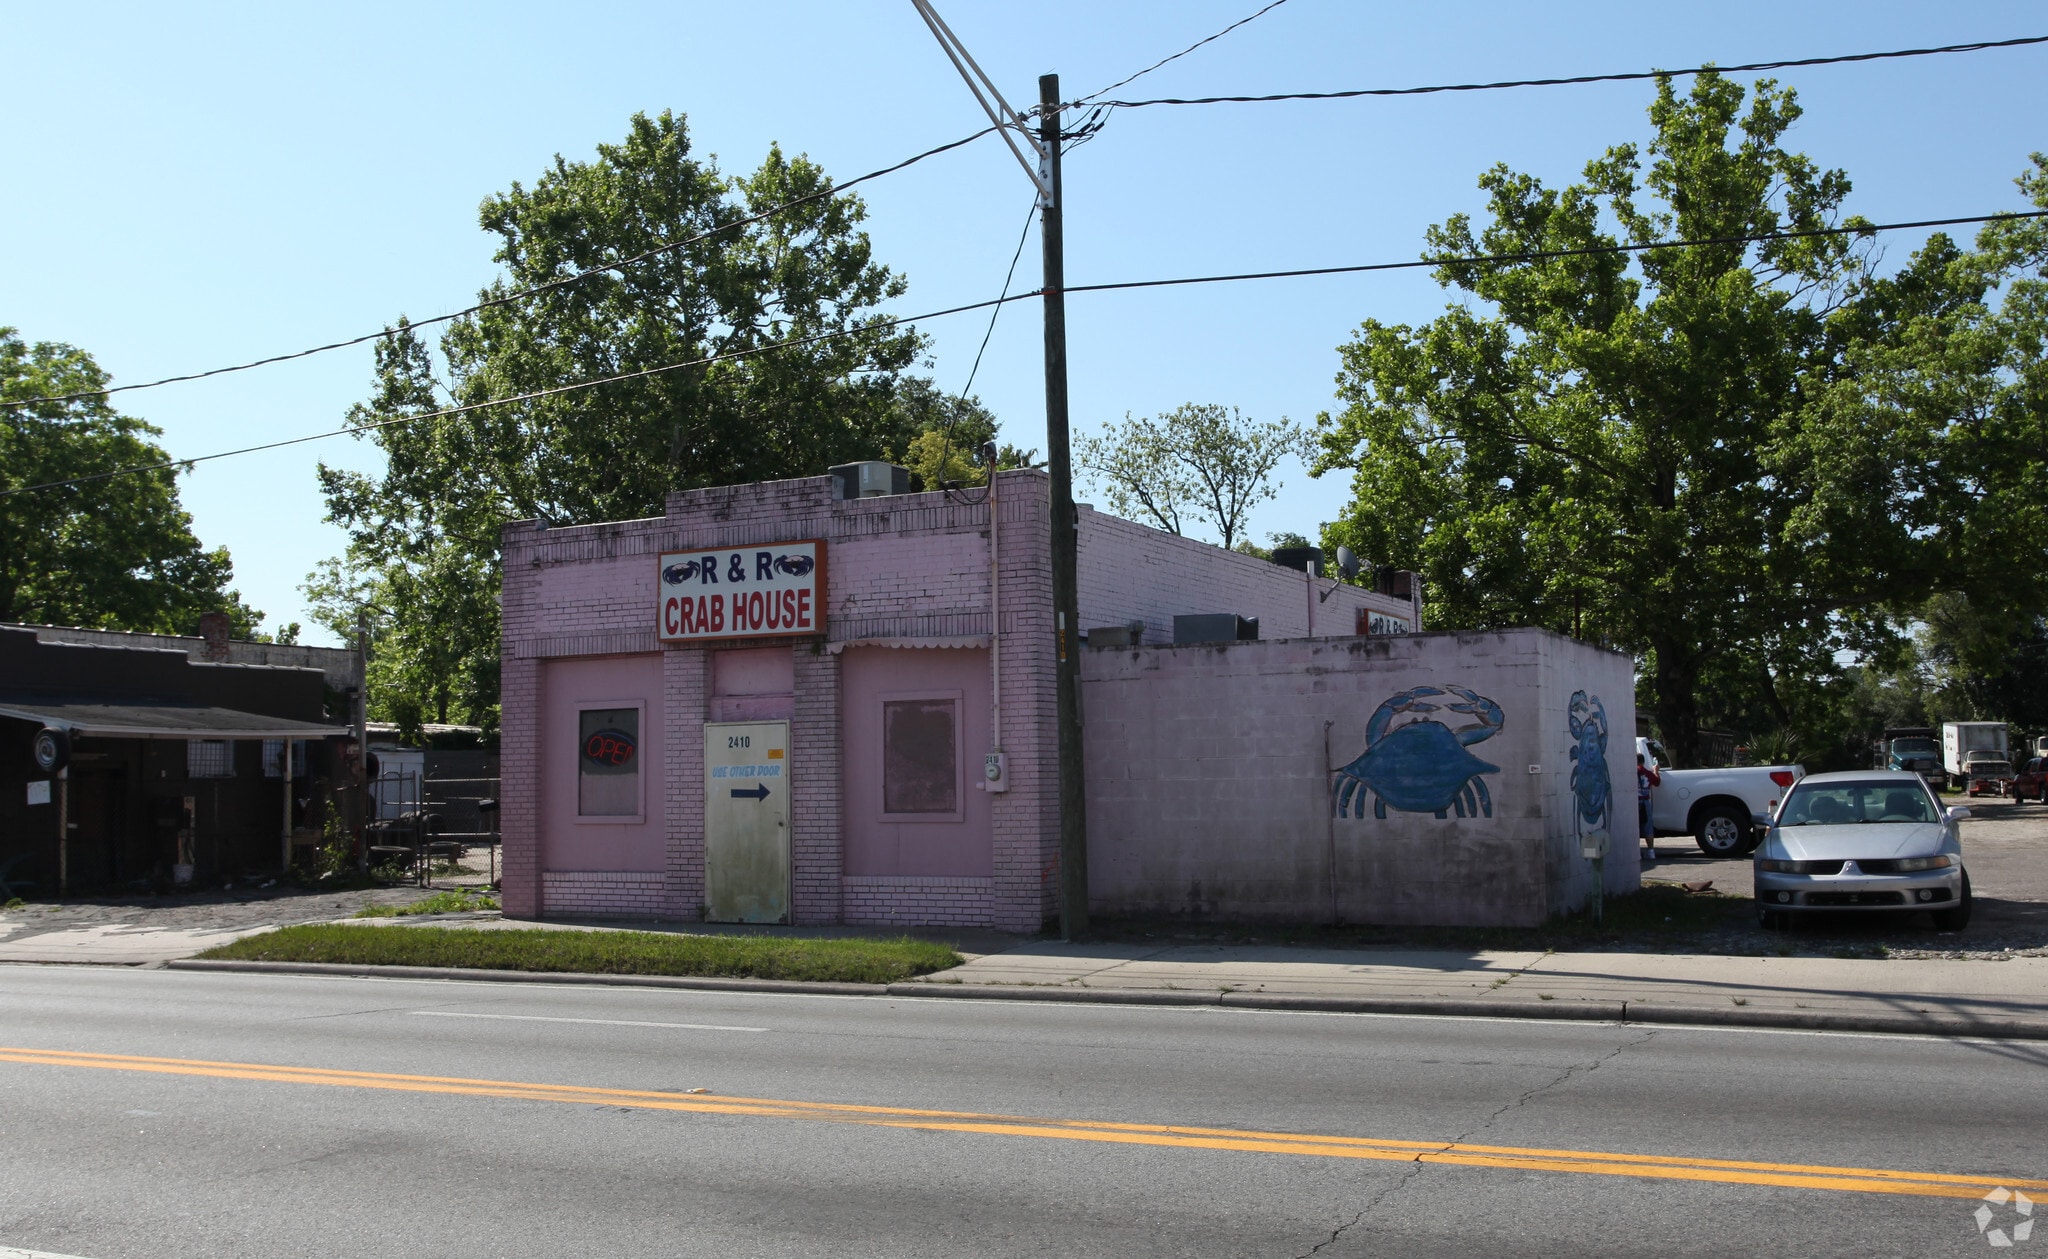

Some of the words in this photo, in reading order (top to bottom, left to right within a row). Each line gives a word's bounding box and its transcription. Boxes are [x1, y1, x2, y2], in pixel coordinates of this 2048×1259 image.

[701, 556, 718, 584] R
[727, 554, 746, 582] &
[756, 552, 773, 580] R
[665, 594, 724, 635] CRAB
[732, 588, 810, 631] HOUSE
[728, 736, 750, 748] 2410
[985, 755, 999, 764] 2410
[712, 766, 728, 778] USE
[730, 765, 756, 778] OTHER
[758, 765, 780, 776] DOOR
